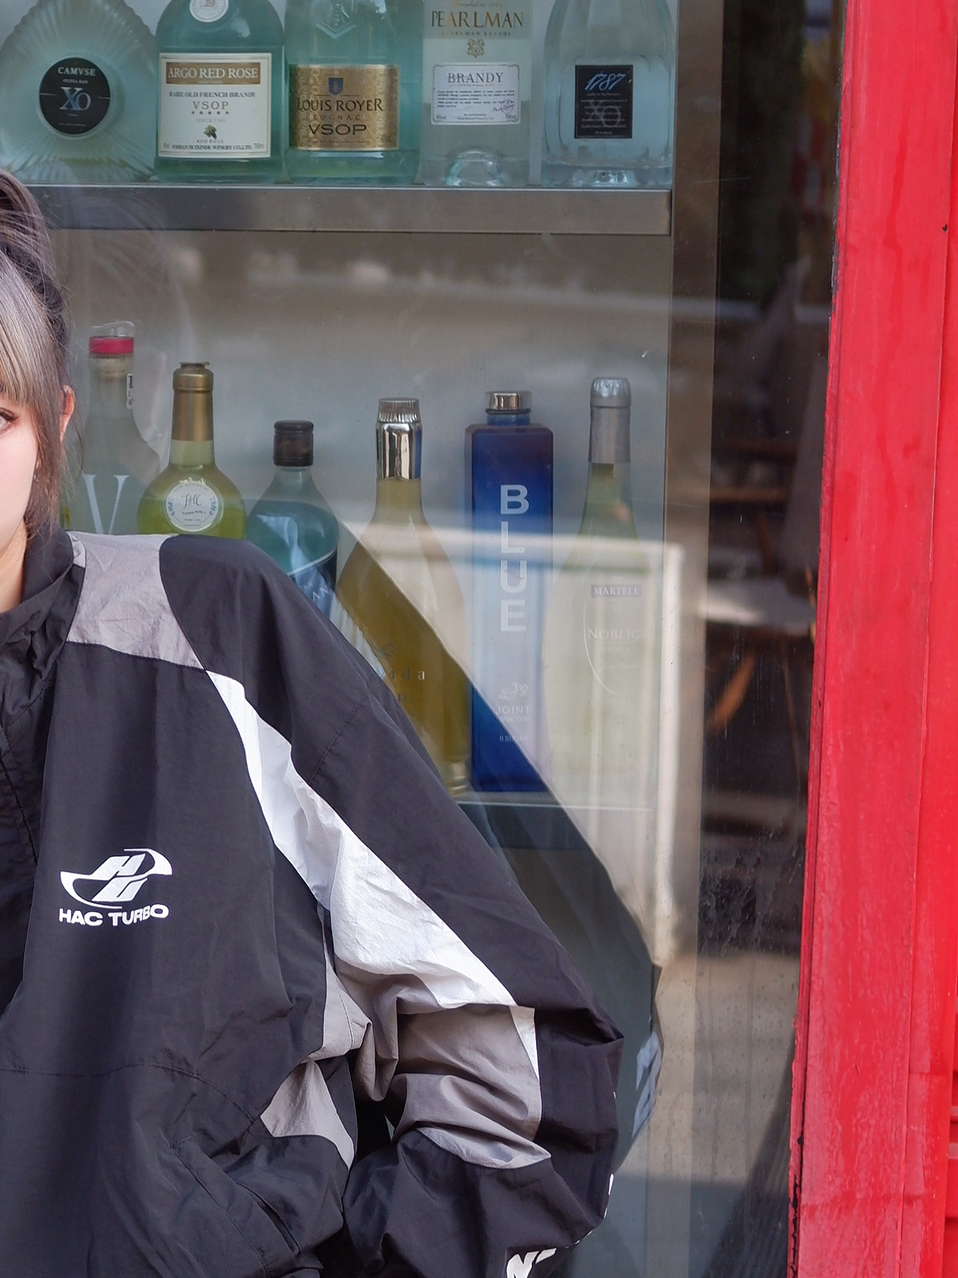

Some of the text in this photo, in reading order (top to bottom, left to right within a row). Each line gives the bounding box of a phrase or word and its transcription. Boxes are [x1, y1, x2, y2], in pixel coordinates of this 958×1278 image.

[431, 10, 524, 28] PEARLMAN
[168, 67, 259, 79] ARGO RED ROSE
[447, 72, 504, 84] BRANDY
[584, 72, 627, 91] 1787
[59, 86, 92, 111] XO
[297, 98, 384, 112] LOUIS ROYER
[192, 101, 229, 110] VSOP
[308, 124, 367, 136] VSOP
[500, 484, 530, 632] BLUE
[594, 587, 638, 596] MARTELL
[498, 705, 531, 714] JOINT
[59, 904, 169, 926] HAC TURBO
